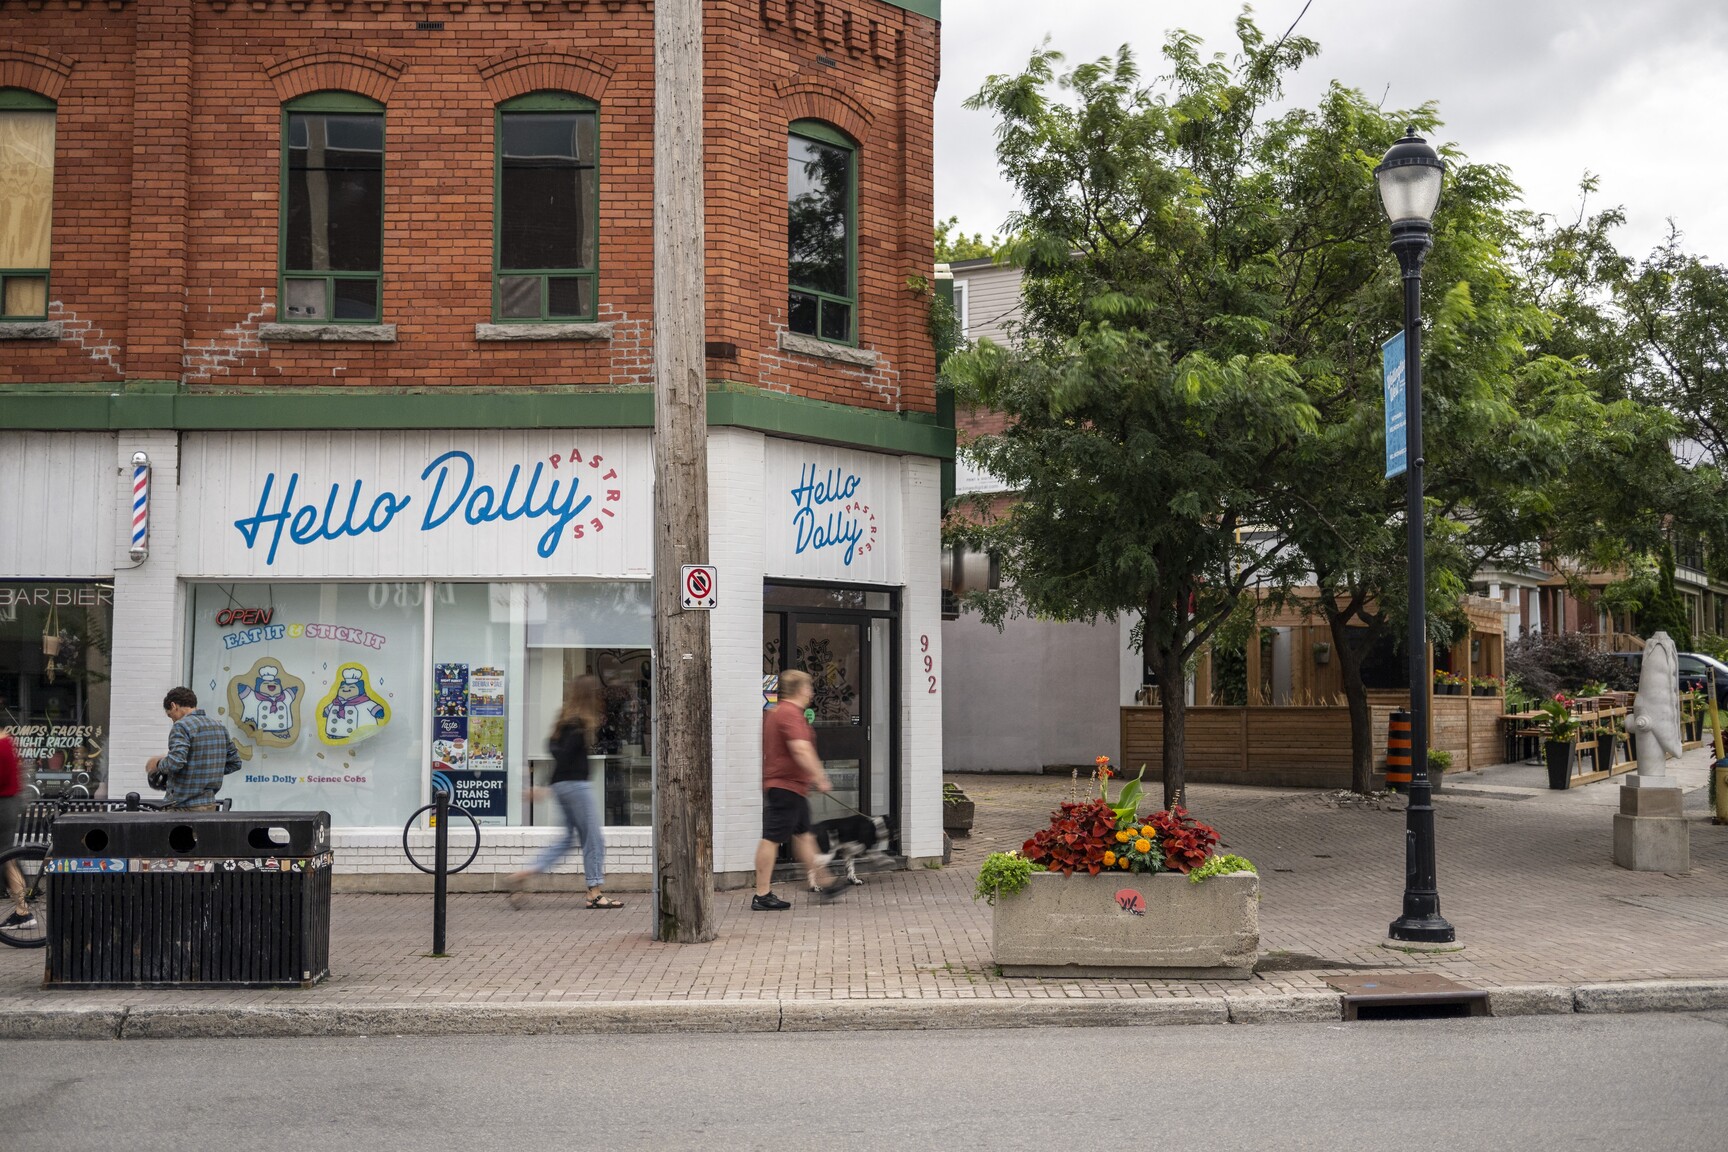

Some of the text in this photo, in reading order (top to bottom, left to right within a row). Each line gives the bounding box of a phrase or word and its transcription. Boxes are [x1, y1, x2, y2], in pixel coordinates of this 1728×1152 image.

[549, 448, 621, 539] PASTRIES
[791, 462, 861, 516] Hello
[234, 450, 592, 566] Hello Dolly
[793, 506, 863, 566] Dolly
[845, 501, 877, 556] PASTRIES
[215, 607, 274, 627] OPEN
[223, 623, 386, 650] EAT IT & STICK IT
[50, 725, 93, 737] FADES
[441, 718, 458, 731] Taste
[46, 736, 84, 748] RAZOR
[245, 775, 270, 783] Hello
[272, 775, 297, 785] Dolly
[307, 775, 341, 783] Science
[344, 775, 366, 783] Cobs
[456, 780, 503, 789] SUPPORT
[456, 790, 489, 799] TRANS
[456, 800, 490, 808] YOUTH
